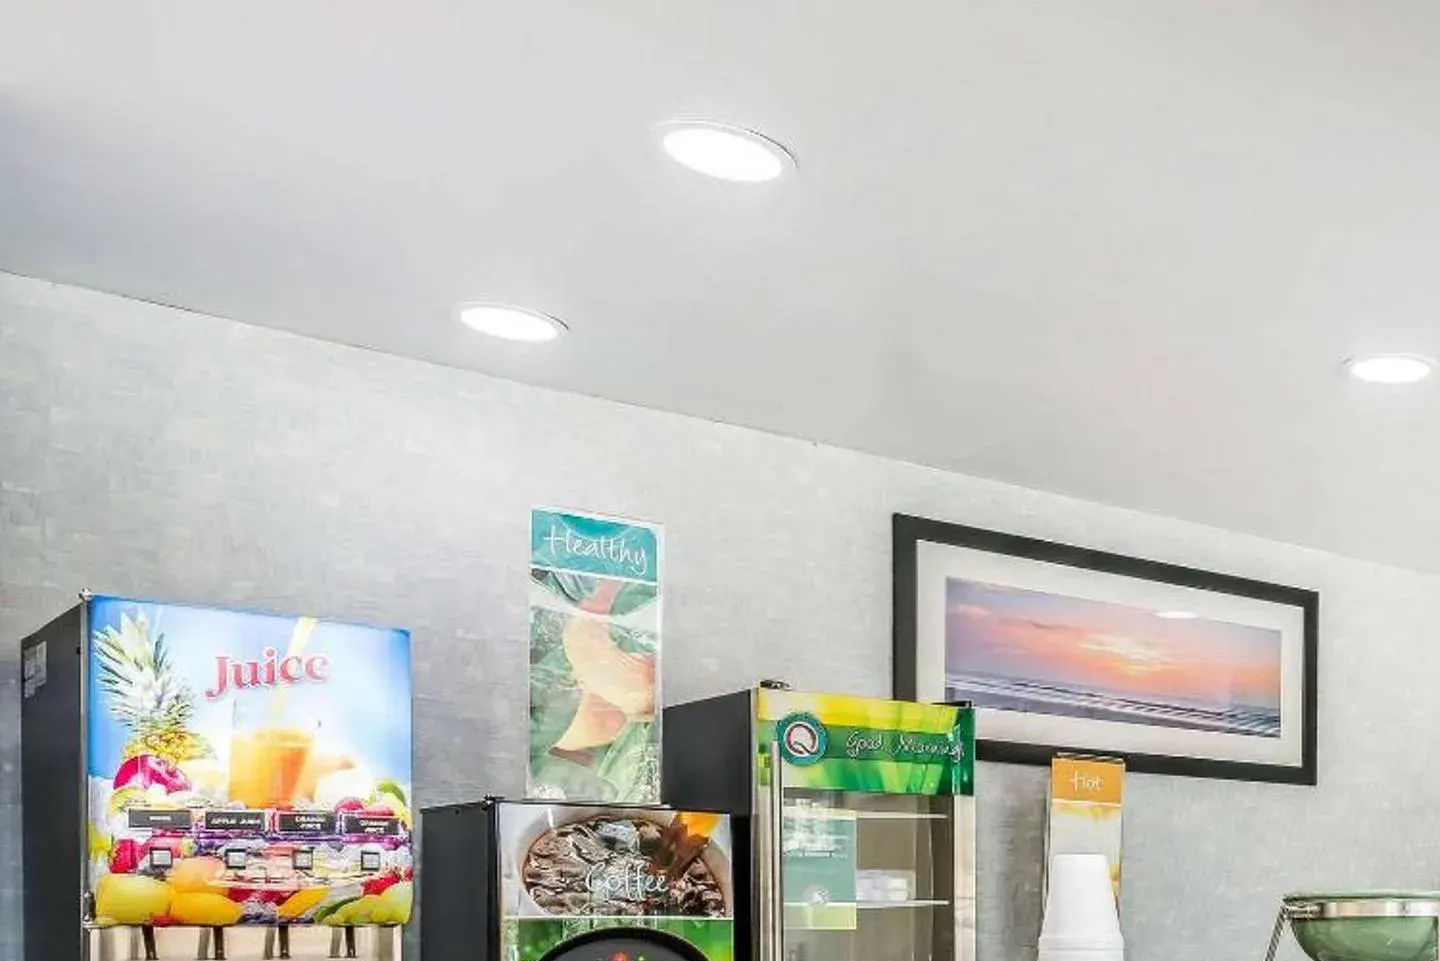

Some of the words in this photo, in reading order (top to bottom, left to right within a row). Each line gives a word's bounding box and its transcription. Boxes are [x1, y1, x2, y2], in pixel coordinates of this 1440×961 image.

[543, 524, 648, 575] Healthy
[205, 648, 329, 699] Juice
[846, 730, 883, 758] Good
[1069, 769, 1104, 792] Hot
[585, 862, 669, 901] Coffee
